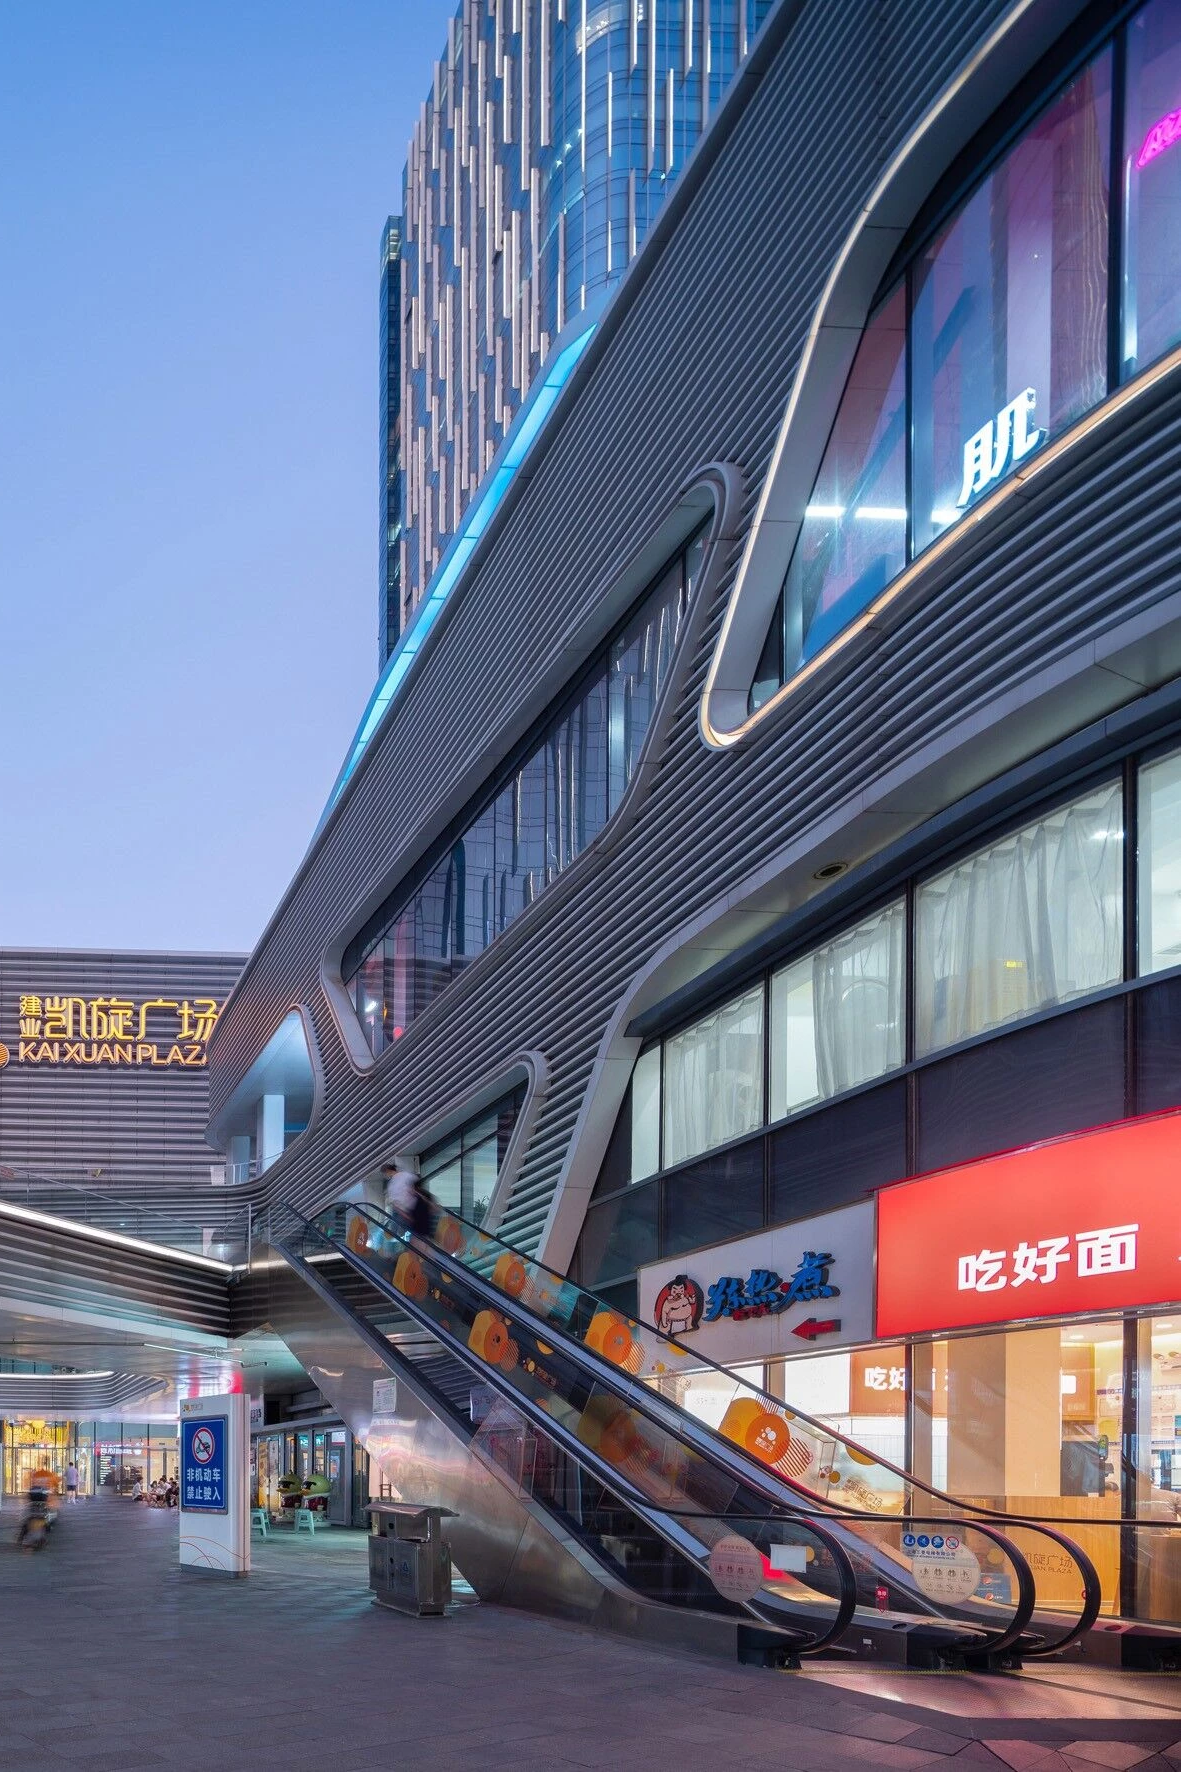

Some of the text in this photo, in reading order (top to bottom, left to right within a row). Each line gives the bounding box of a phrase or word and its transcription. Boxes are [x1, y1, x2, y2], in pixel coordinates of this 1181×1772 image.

[44, 996, 219, 1042] 凯旋广场
[957, 1223, 1139, 1292] 吃好面
[186, 1467, 221, 1482] 非机动车
[186, 1486, 221, 1501] 禁止驶入
